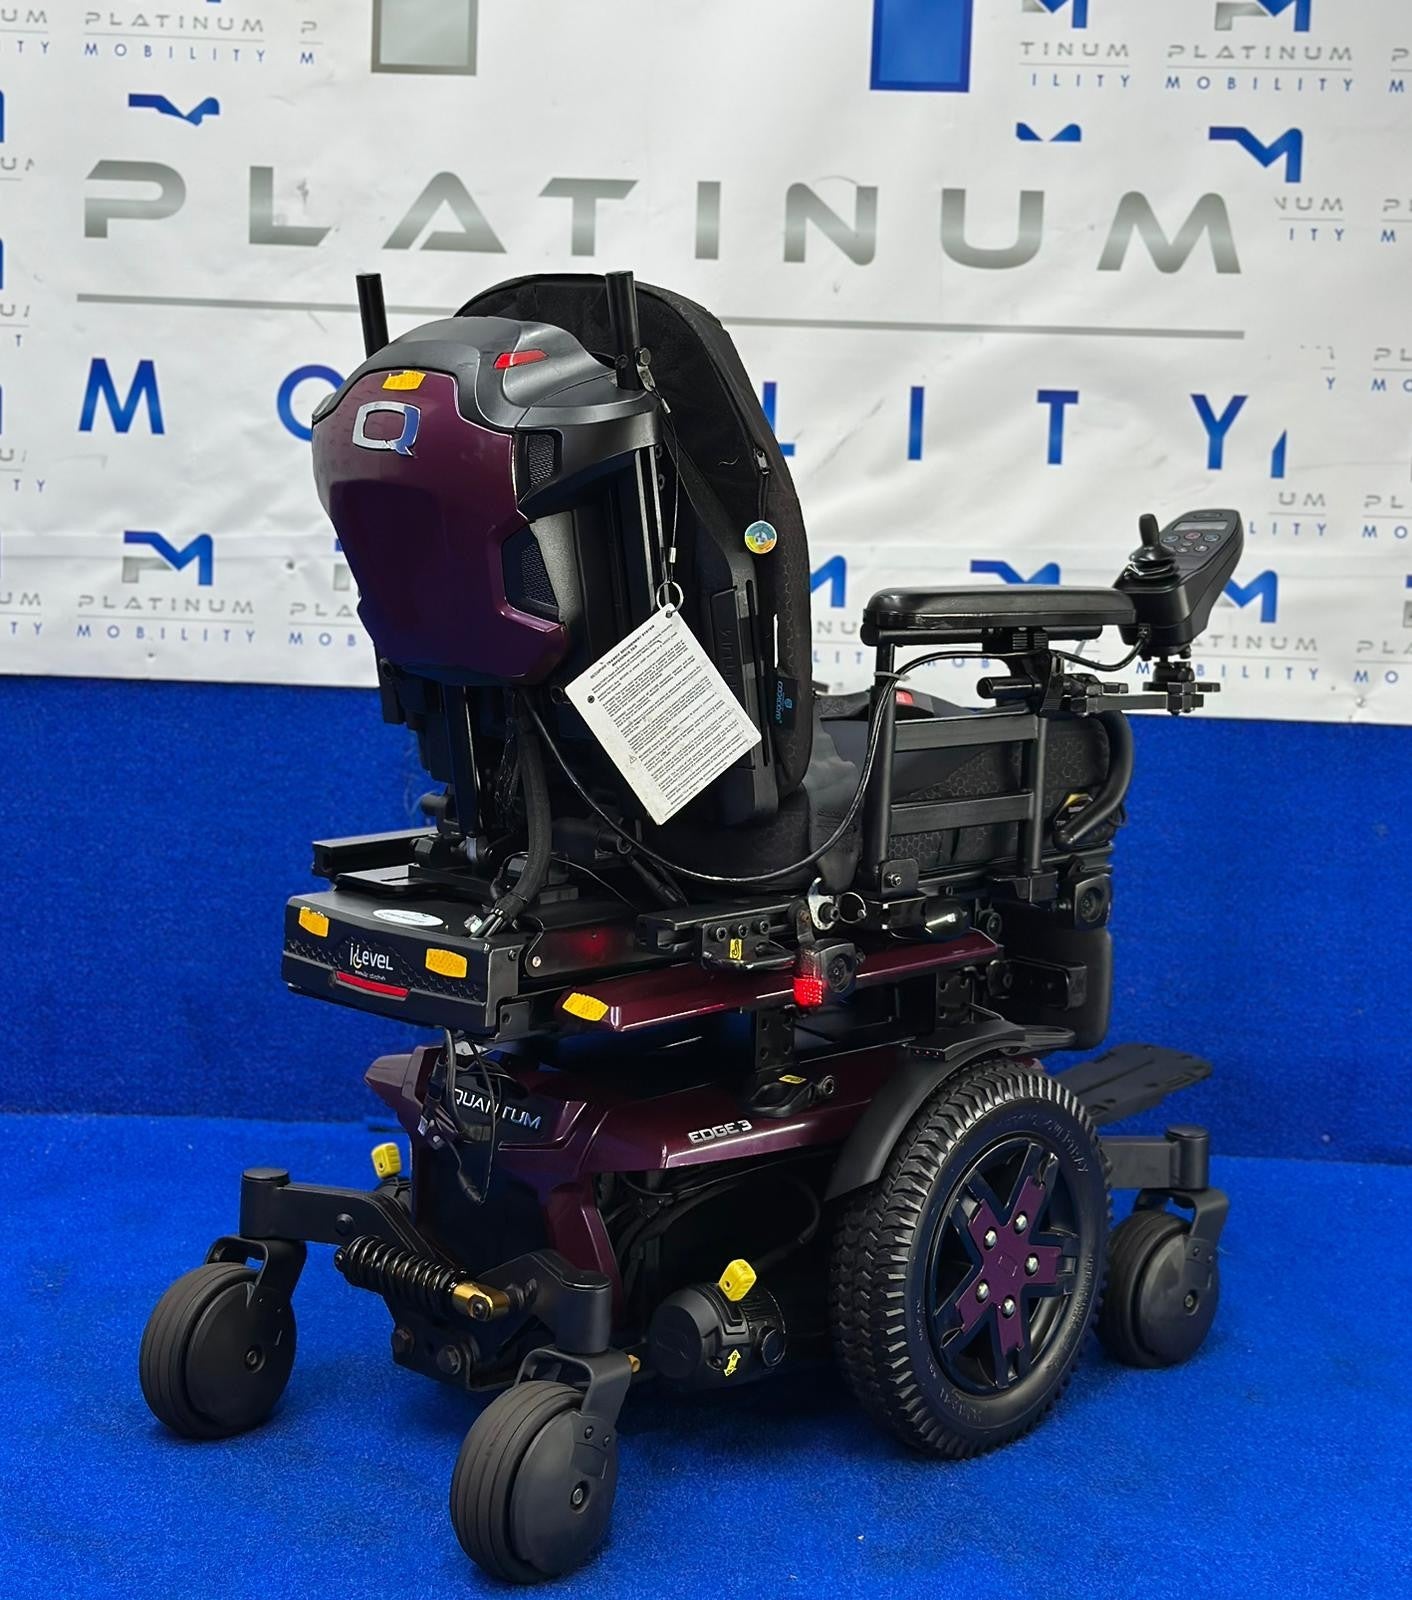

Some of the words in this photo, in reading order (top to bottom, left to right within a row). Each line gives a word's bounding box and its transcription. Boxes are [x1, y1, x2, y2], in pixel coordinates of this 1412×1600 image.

[84, 12, 264, 32] PLATINUM
[84, 43, 265, 63] MOBILITY
[1167, 45, 1353, 61] PLATINUM
[1165, 76, 1353, 92] MOBILITY
[84, 158, 1242, 275] PLATINUM
[78, 595, 254, 614] PLATINUM
[77, 624, 256, 643] MOBILITY
[1135, 661, 1319, 681] MBILITY
[688, 1122, 740, 1144] EDGE
[737, 1119, 753, 1132] 3
